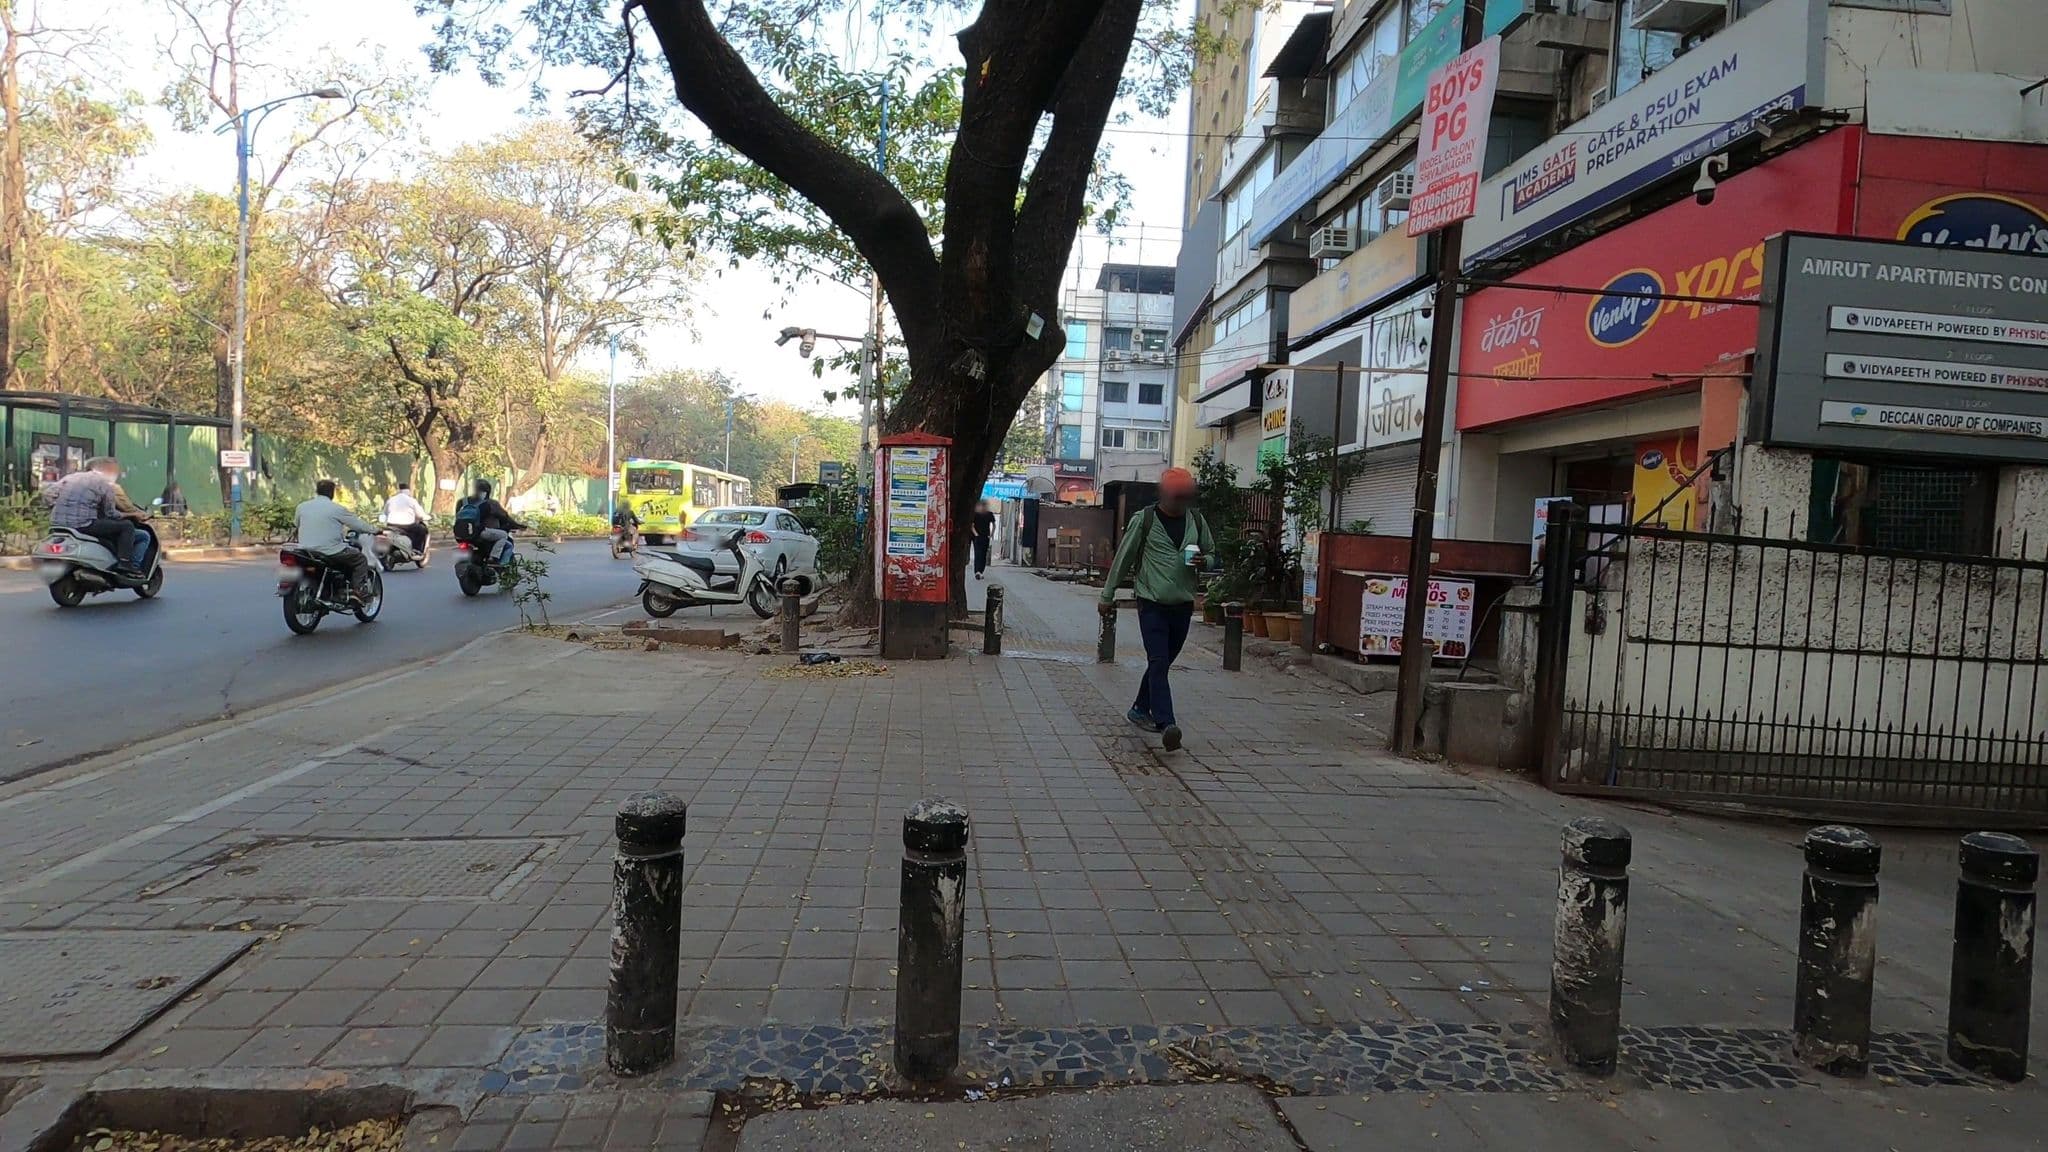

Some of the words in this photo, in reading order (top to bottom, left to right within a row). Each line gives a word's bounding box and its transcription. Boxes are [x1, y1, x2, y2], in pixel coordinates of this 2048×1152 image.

[1427, 58, 1484, 114] BOYS
[1587, 121, 1625, 153] GATE
[1630, 113, 1639, 129] &
[1645, 89, 1679, 121] PSU
[1684, 53, 1738, 99] EXAM
[1432, 102, 1468, 152] PG
[1586, 99, 1700, 175] PREPARATION
[1419, 155, 1443, 173] MODEL
[1443, 137, 1477, 160] COLONY
[1519, 164, 1539, 188] IMS
[1543, 141, 1577, 171] GATE
[1517, 160, 1576, 203] ACADEMY
[1801, 258, 1871, 279] AMRUT
[1876, 264, 2003, 290] APARTMENTS
[1593, 285, 1654, 336] Venky's
[1863, 316, 1932, 331] VIDYAPEETH
[1937, 322, 1989, 336] POWERED
[1993, 326, 2007, 337] BY
[2009, 327, 2048, 341] PHYSIC
[1375, 307, 1417, 369] GIVA
[1860, 364, 1931, 378] VIDYAPEETH
[1934, 369, 1987, 383] POWERED
[1991, 374, 2005, 384] BY
[1371, 387, 1416, 436] जीवा
[1880, 411, 1924, 425] DECCAN
[1927, 414, 1963, 428] GROUP
[1966, 417, 1980, 429] OF
[1983, 419, 2042, 434] COMPANIES
[1391, 587, 1448, 602] MOS
